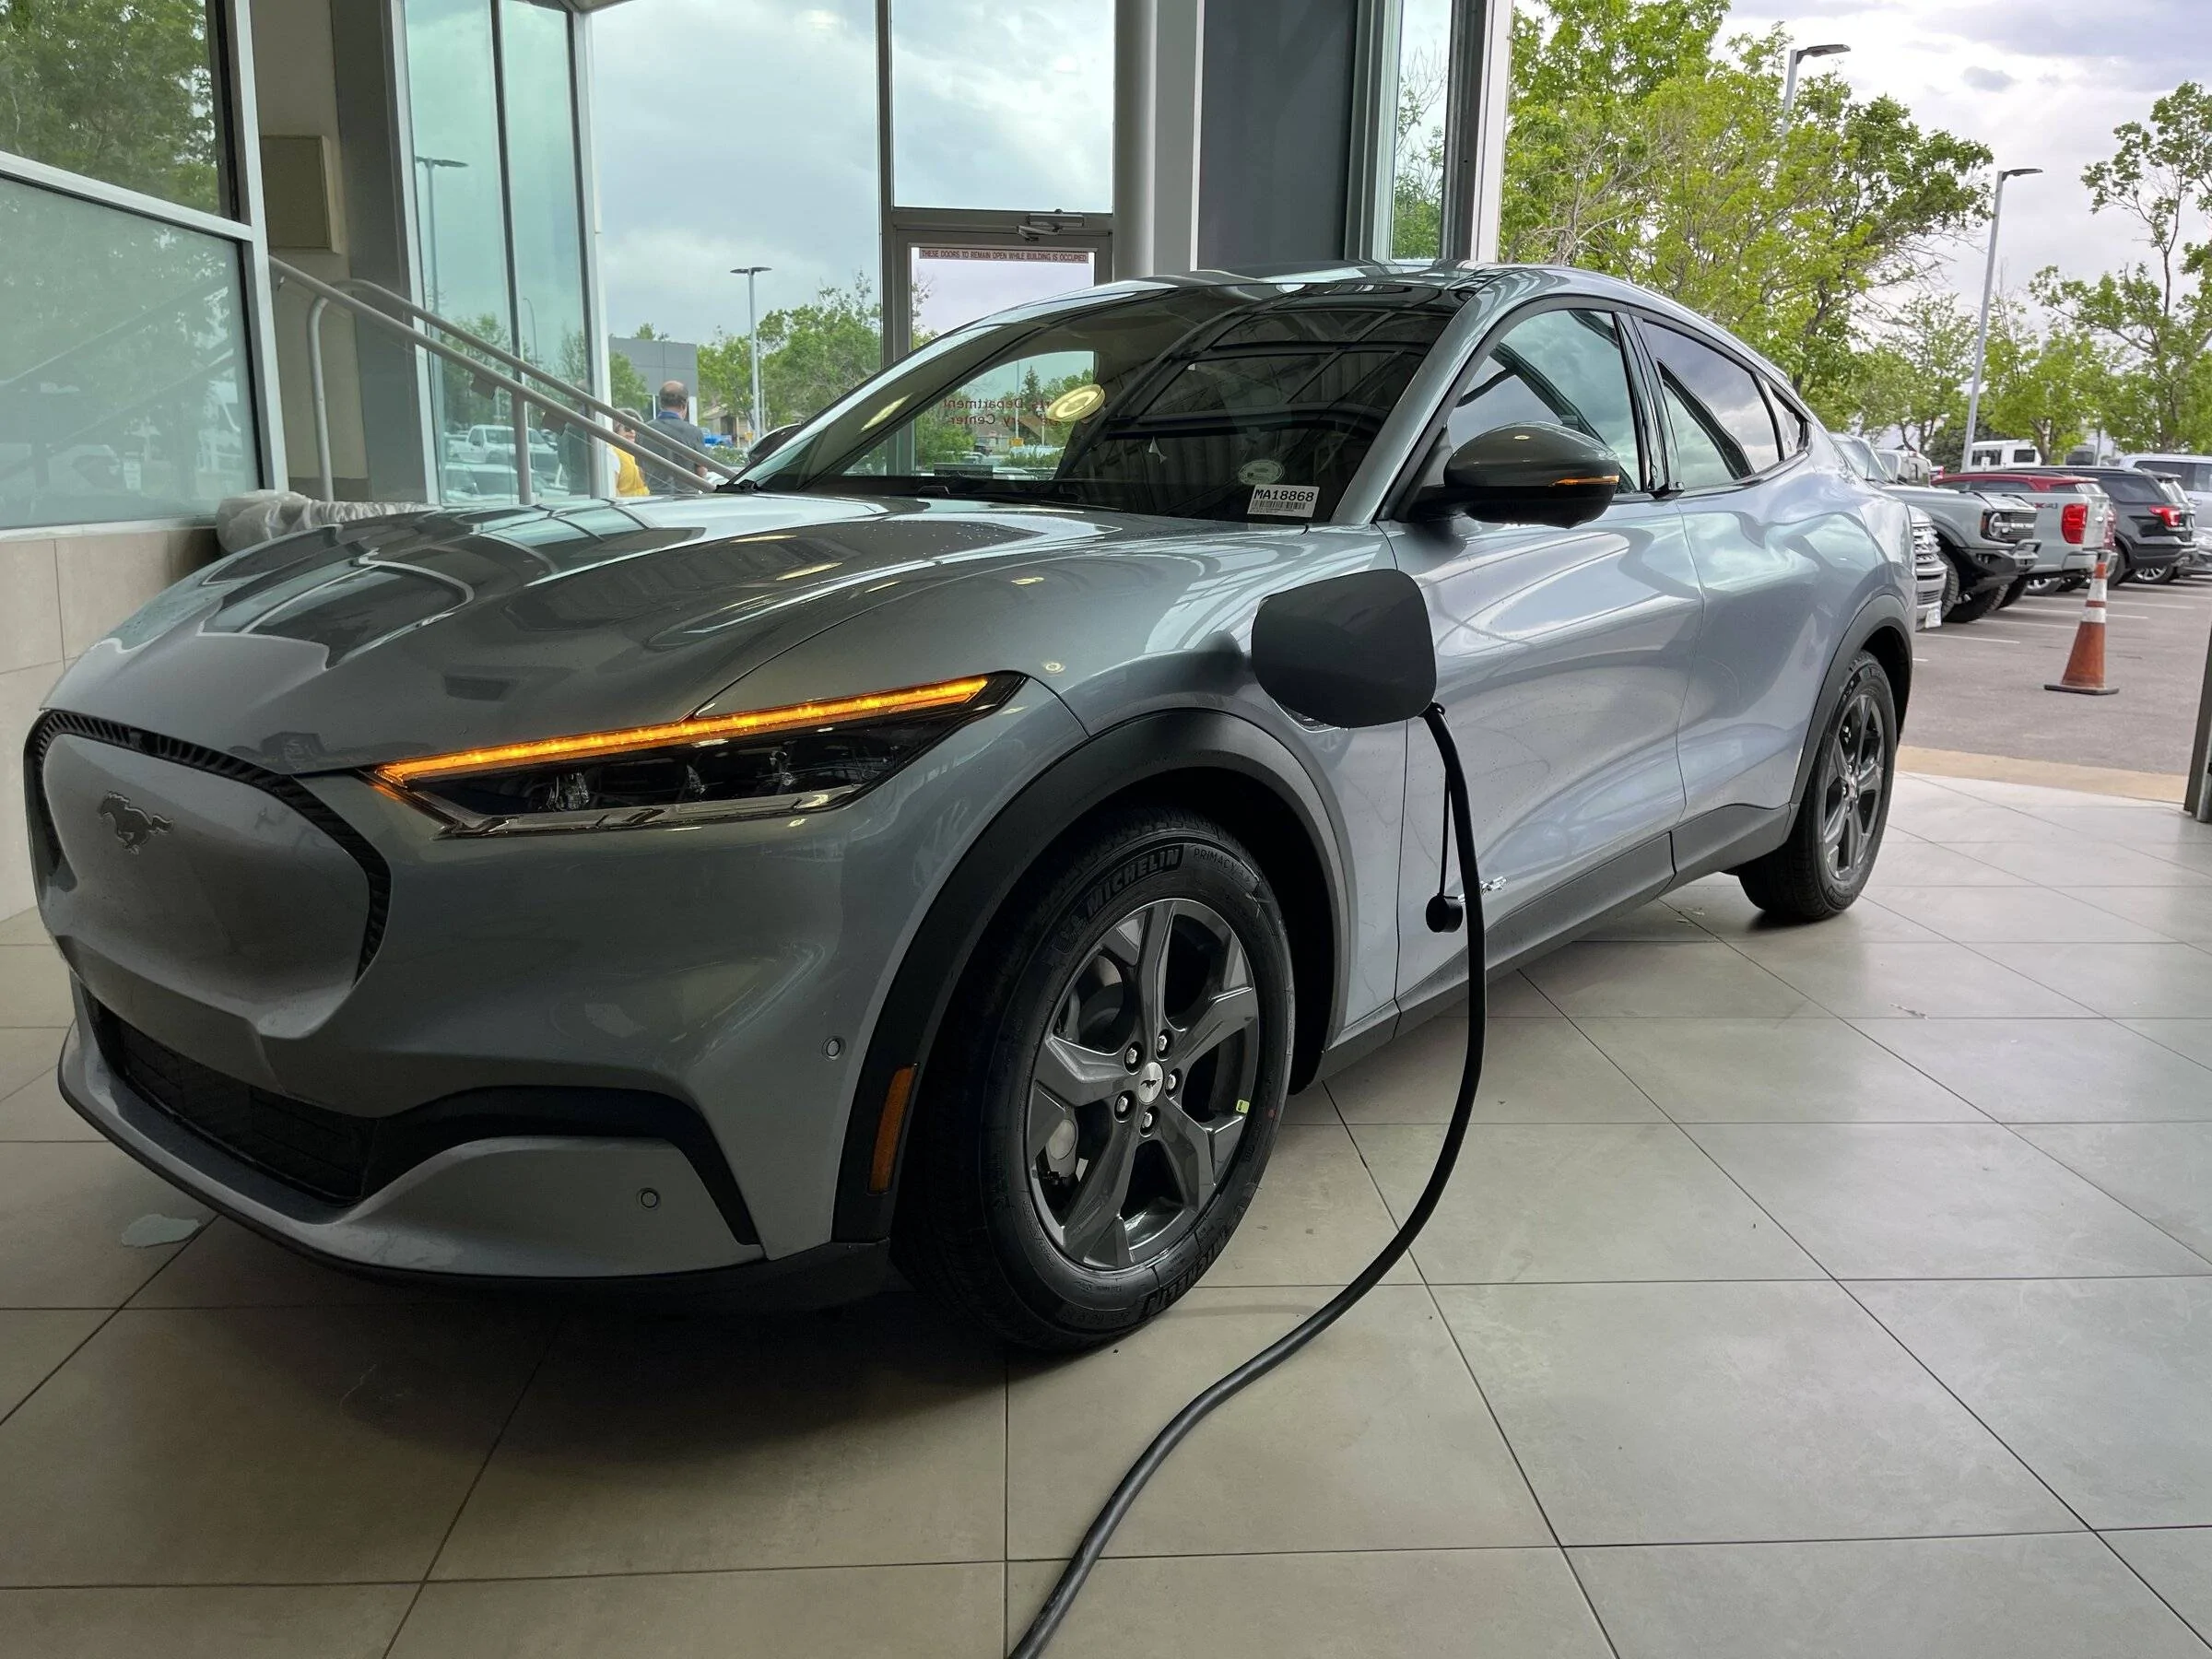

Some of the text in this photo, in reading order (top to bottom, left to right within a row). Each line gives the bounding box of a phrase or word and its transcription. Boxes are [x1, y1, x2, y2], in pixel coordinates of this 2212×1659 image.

[1027, 253, 1051, 261] BUILDING
[1060, 253, 1087, 262] OCCUPIED
[1253, 489, 1314, 502] MA18868
[1087, 847, 1237, 918] MICHELIN PRIMACY
